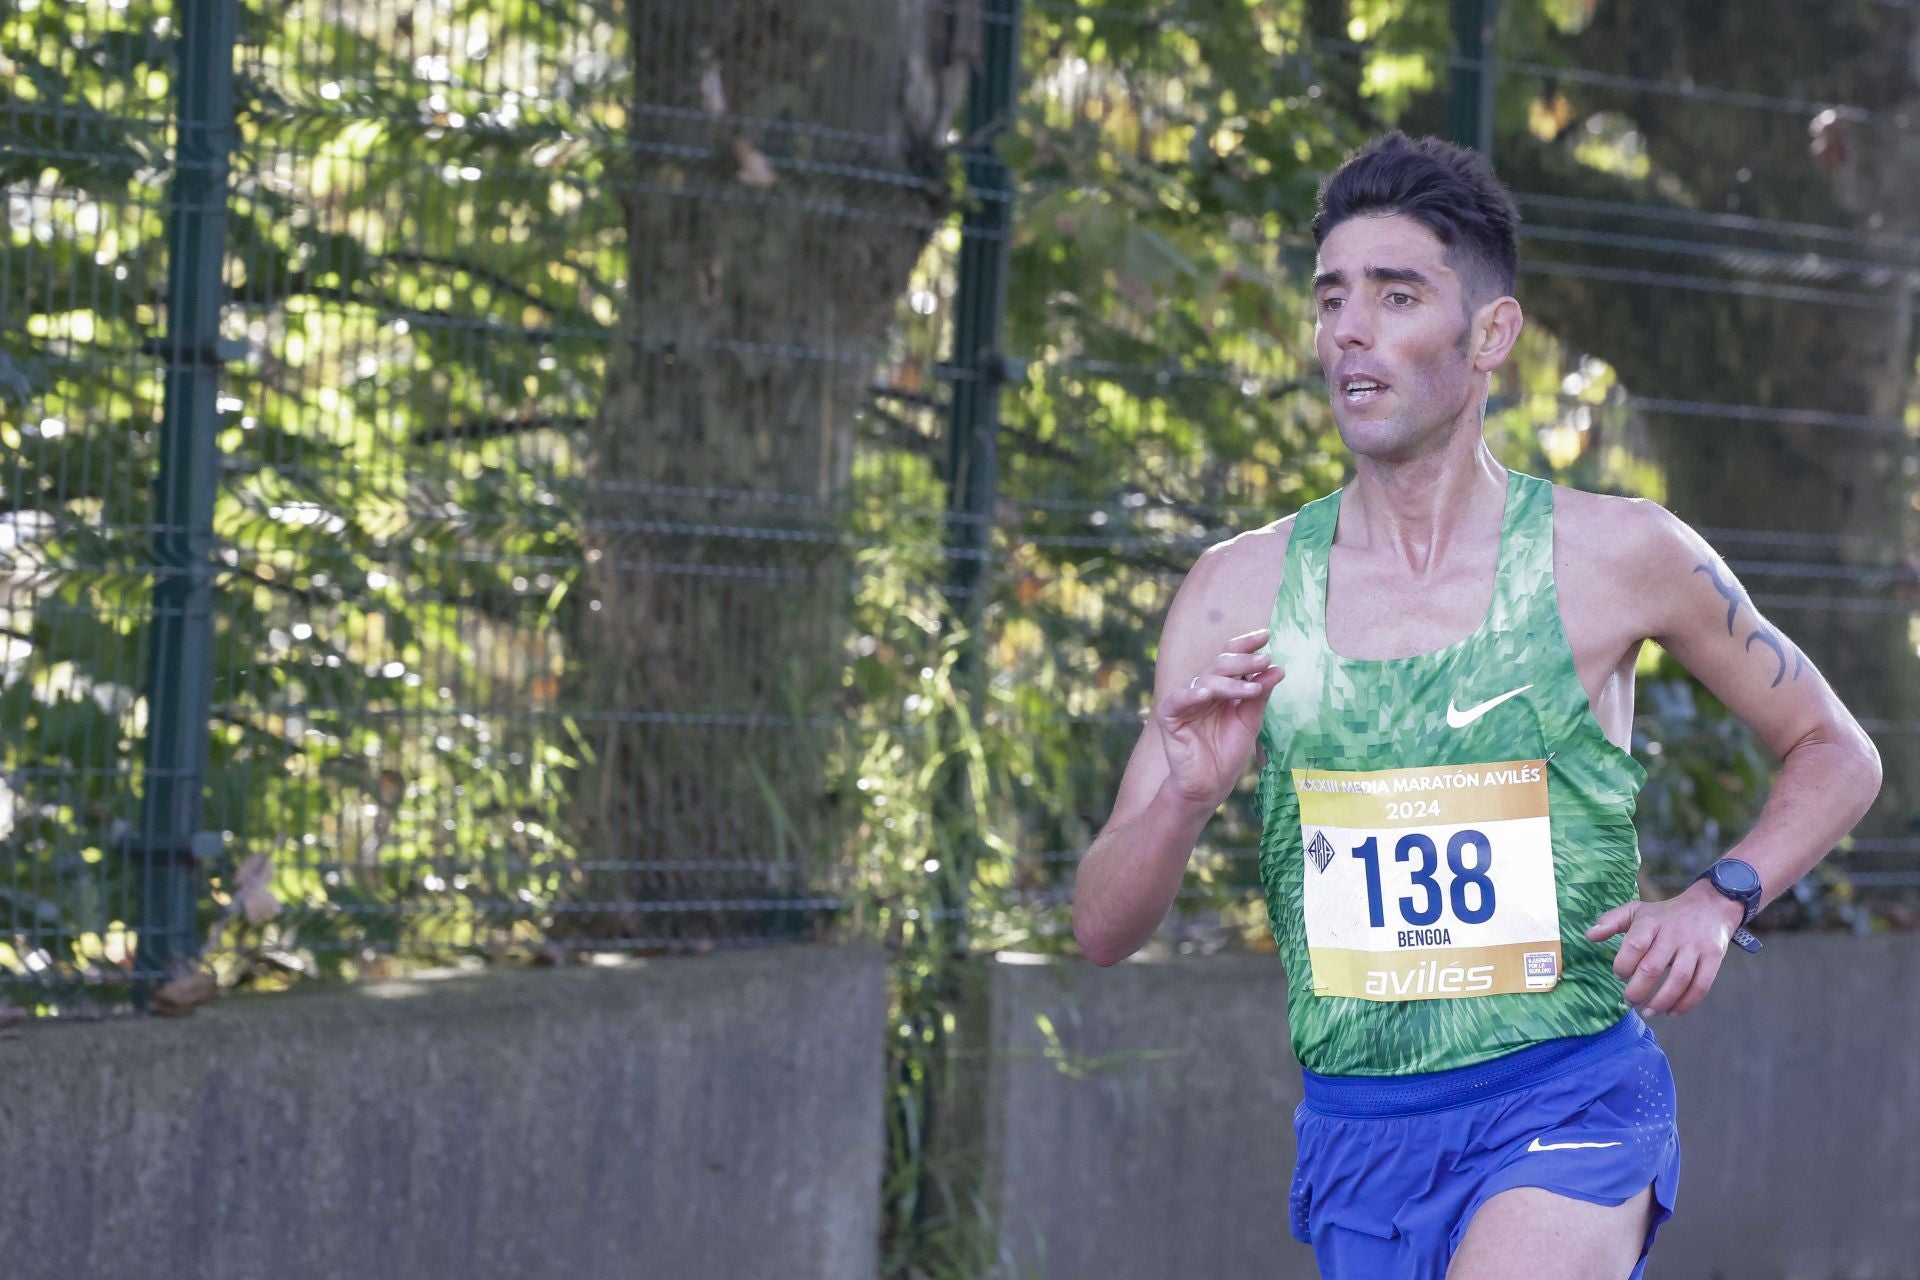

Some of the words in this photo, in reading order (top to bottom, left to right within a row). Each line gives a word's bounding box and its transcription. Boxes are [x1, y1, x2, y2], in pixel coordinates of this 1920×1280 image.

[1341, 780, 1390, 794] MEDIA
[1393, 769, 1480, 792] MARATÓN
[1484, 765, 1541, 786] AVILÉS
[1386, 800, 1441, 820] 2024
[1351, 829, 1496, 928] 138
[1397, 928, 1452, 948] BENGOA
[1365, 960, 1495, 996] avilés
